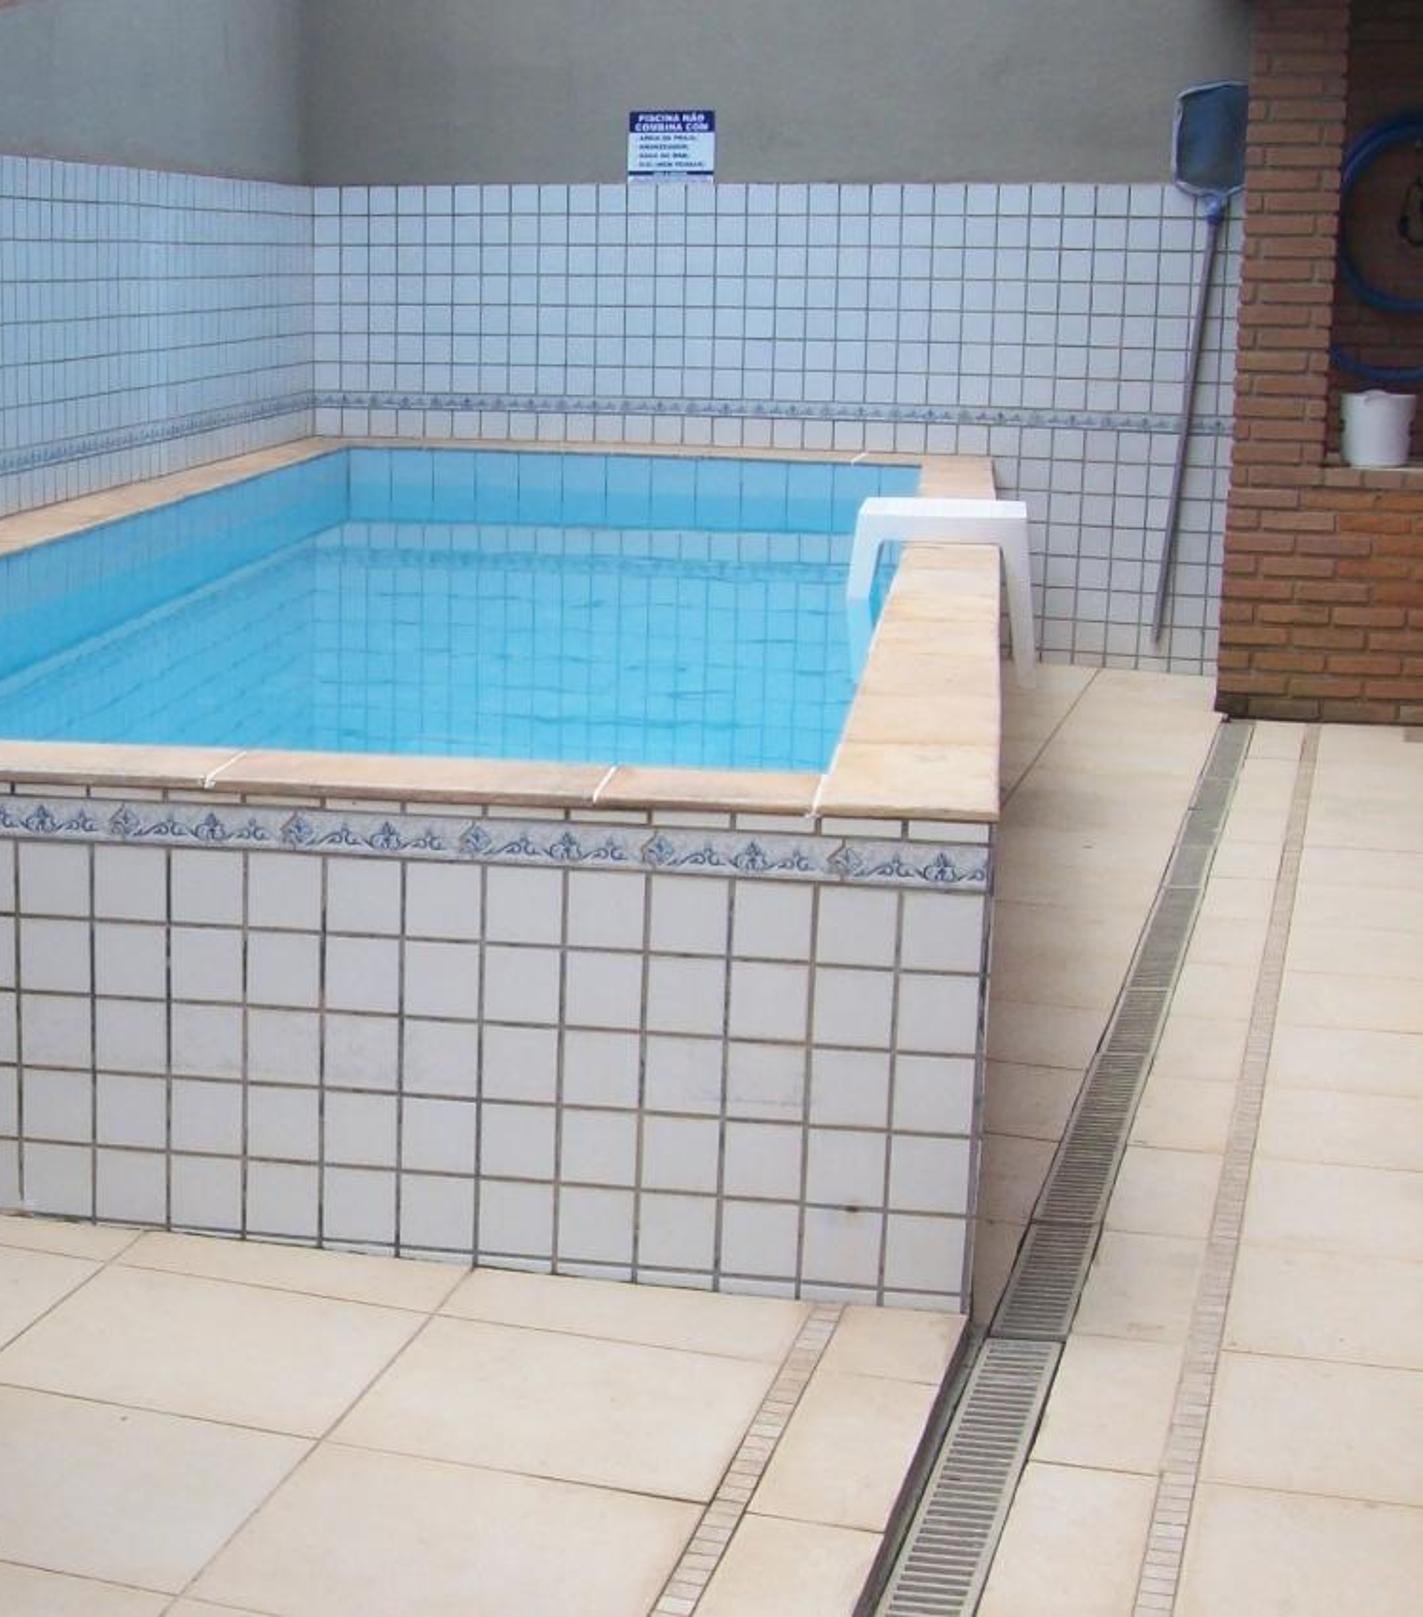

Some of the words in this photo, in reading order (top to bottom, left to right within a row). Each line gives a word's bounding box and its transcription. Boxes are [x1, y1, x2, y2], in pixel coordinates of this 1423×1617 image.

[638, 114, 680, 122] PISCINA
[682, 113, 705, 122] NÃO
[635, 123, 682, 131] COMBINA
[686, 123, 709, 131] COM
